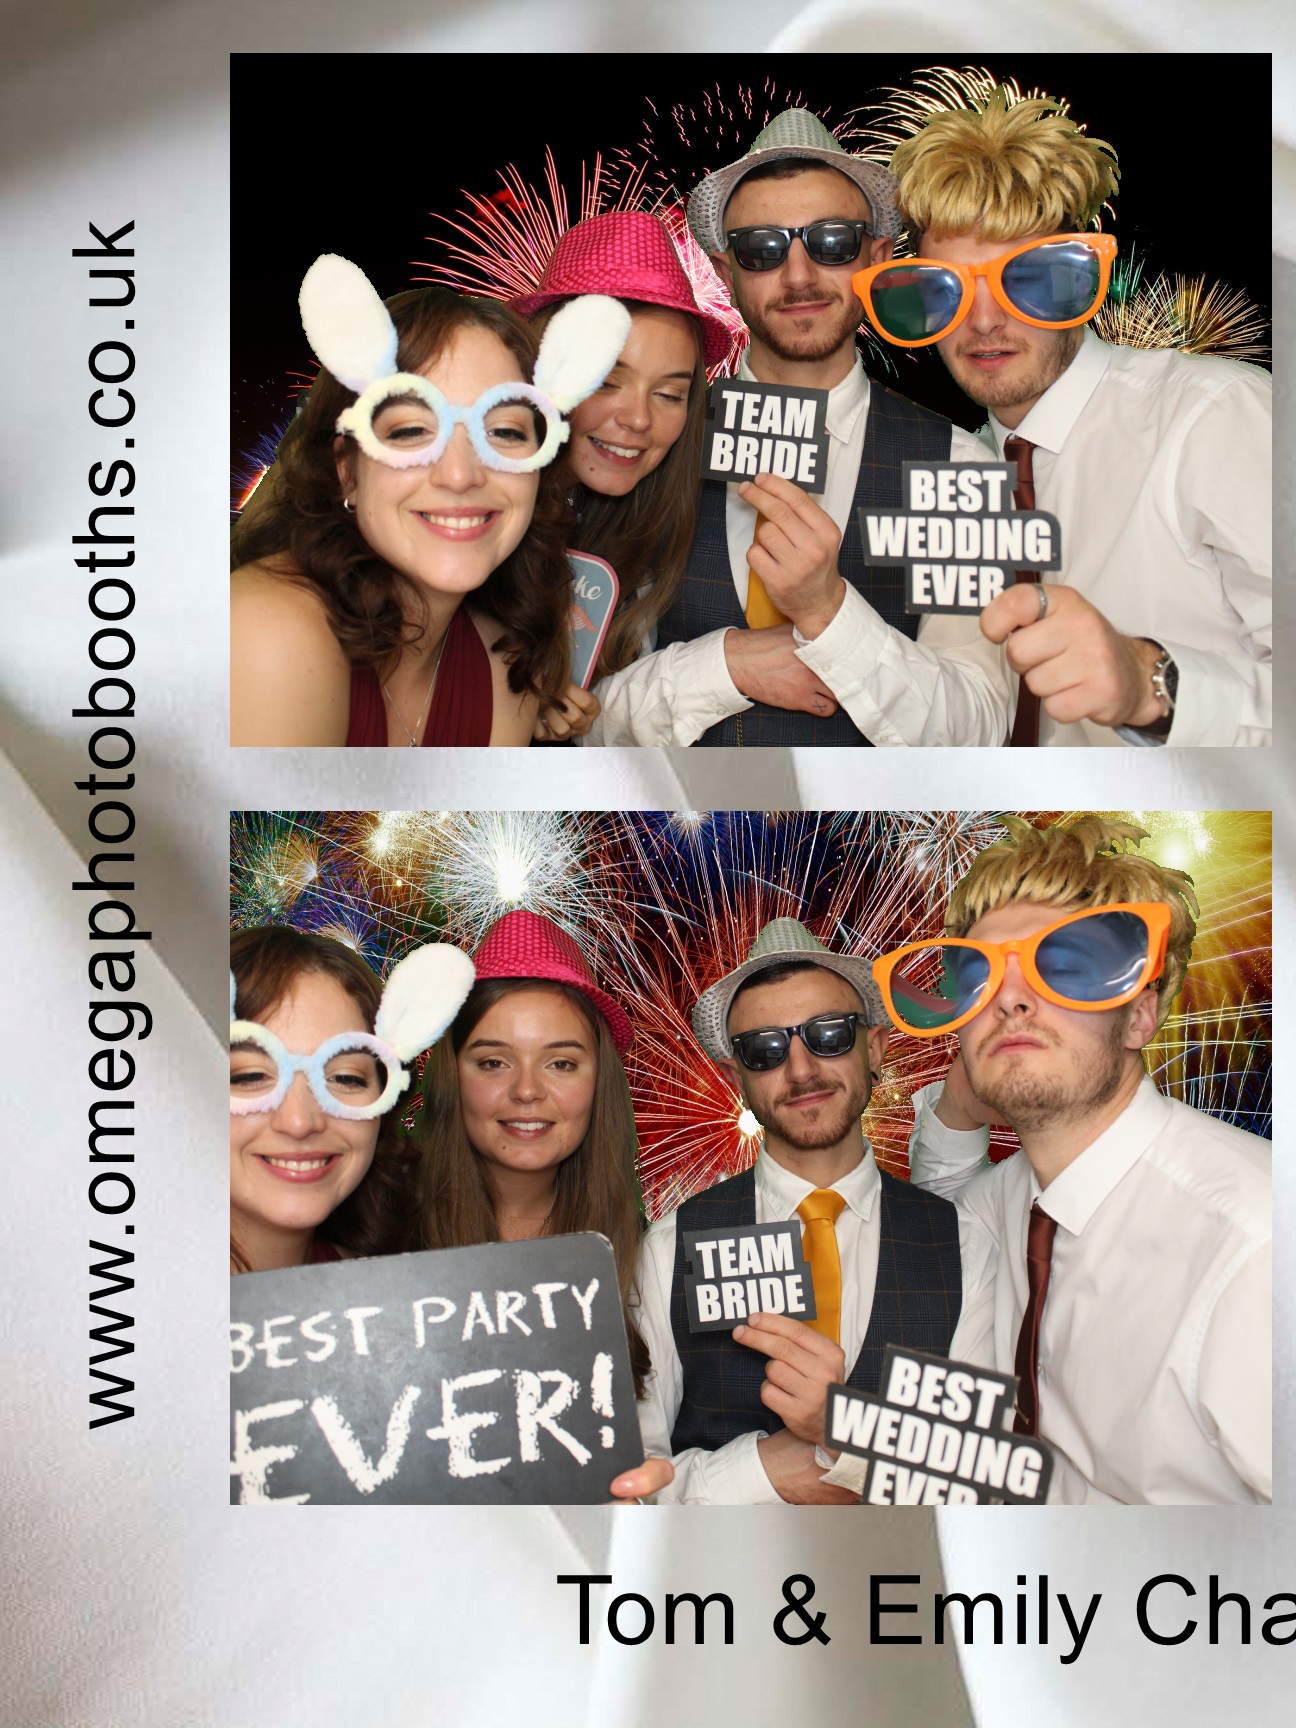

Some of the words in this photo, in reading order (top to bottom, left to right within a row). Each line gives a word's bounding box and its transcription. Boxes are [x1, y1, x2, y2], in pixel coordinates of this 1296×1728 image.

[721, 390, 818, 439] TEAM
[709, 432, 819, 484] BRIDE
[909, 469, 1008, 513] BEST
[865, 515, 1052, 563] WEDDING
[911, 563, 1006, 607] EVER
[695, 1232, 795, 1280] TEAM
[696, 1273, 807, 1323] BRIDE
[230, 1305, 384, 1374] BEST
[411, 1277, 600, 1349] PARTY
[886, 1355, 1006, 1430] BEST
[230, 1351, 616, 1505] EVER!
[831, 1393, 1044, 1499] WEDDING
